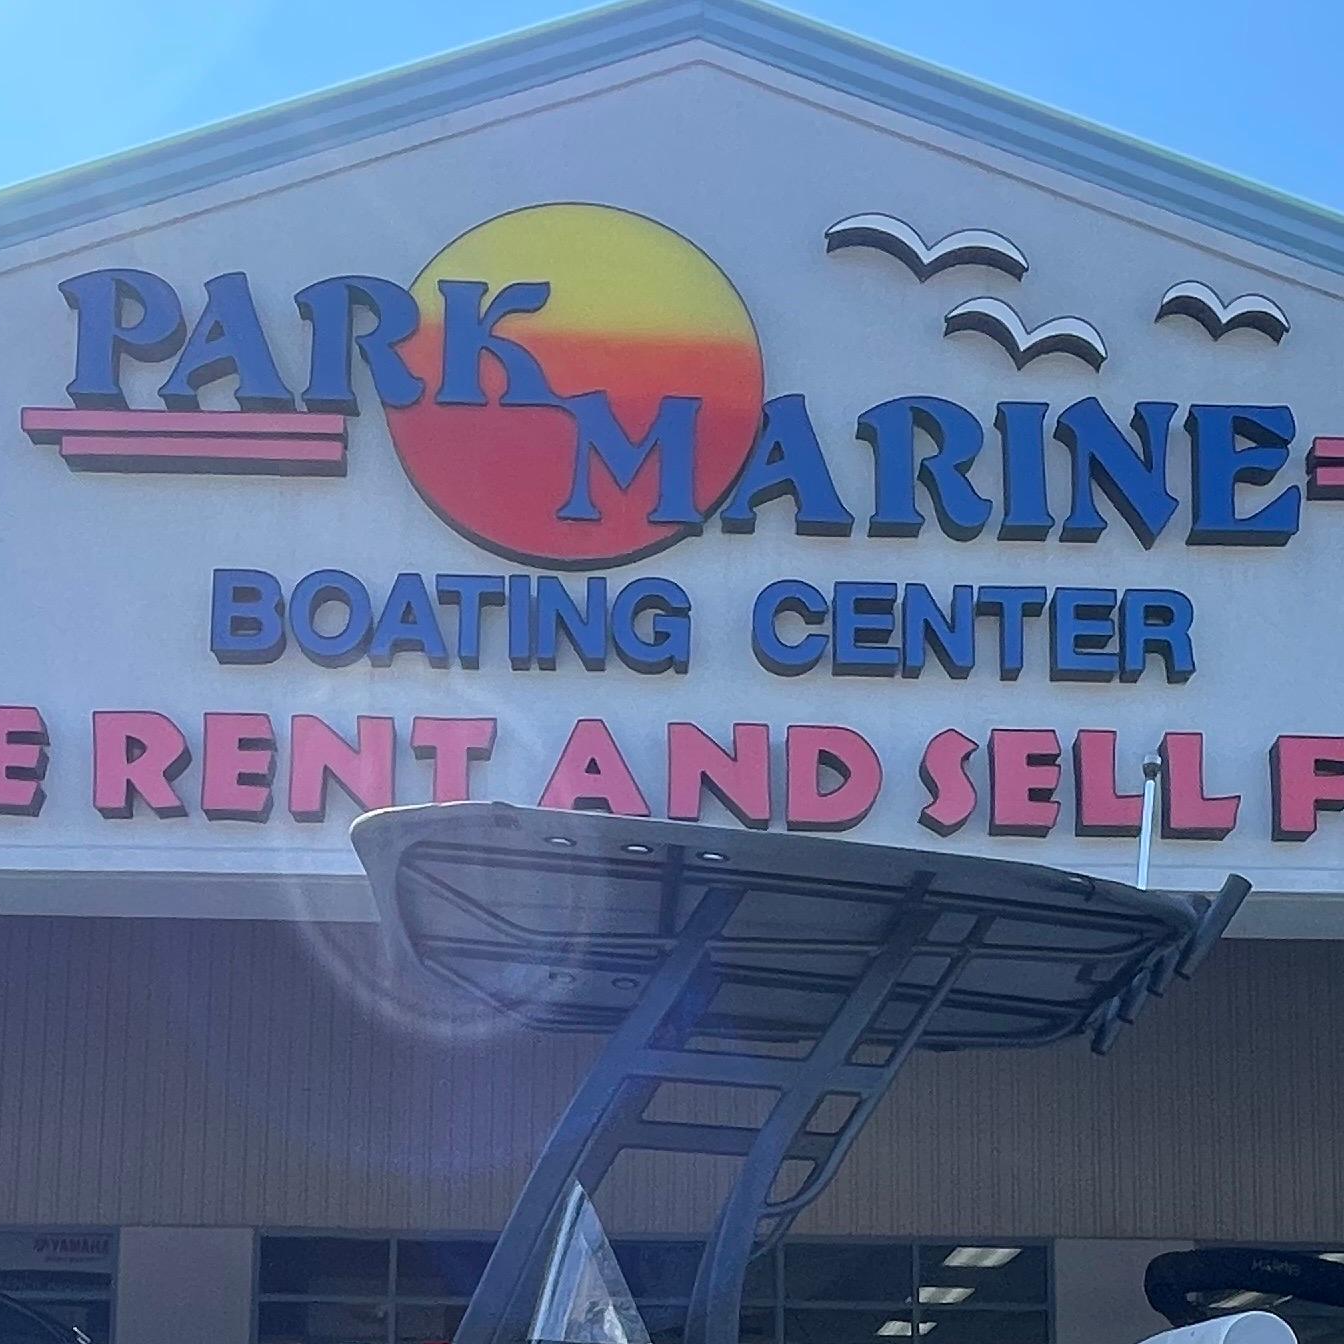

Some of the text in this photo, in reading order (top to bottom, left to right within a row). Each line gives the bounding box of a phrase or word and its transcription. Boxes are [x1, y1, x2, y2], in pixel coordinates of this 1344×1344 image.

[58, 268, 1302, 550] PARK MARINE
[210, 568, 1197, 684] BOATING CENTER
[92, 710, 497, 823] RENT
[537, 717, 884, 832] AND
[918, 728, 1241, 841] SELL
